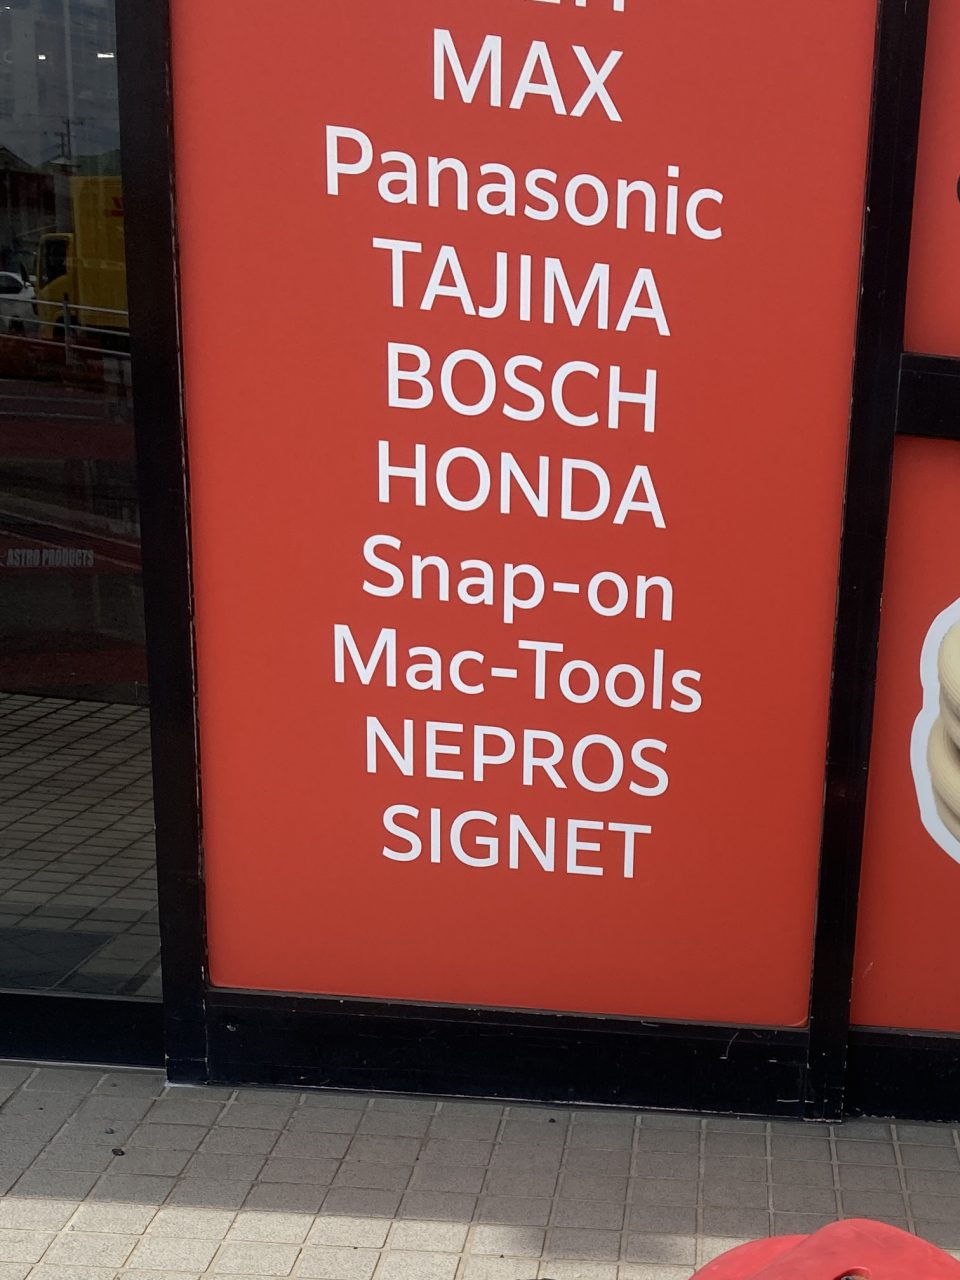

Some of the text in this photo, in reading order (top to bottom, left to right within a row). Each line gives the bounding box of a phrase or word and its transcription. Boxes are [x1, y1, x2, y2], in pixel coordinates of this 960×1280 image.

[434, 29, 624, 122] MAX
[326, 124, 724, 240] Panasonic
[373, 238, 671, 337] TAJIMA
[387, 342, 657, 433] BOSCH
[379, 440, 667, 529] HONDA
[7, 548, 95, 568] ASTRO PRODUCTS
[363, 535, 673, 624] Snap-on
[334, 624, 702, 713] Mac-Tools
[366, 716, 669, 797] NEPROS
[382, 805, 652, 879] SIGNET
